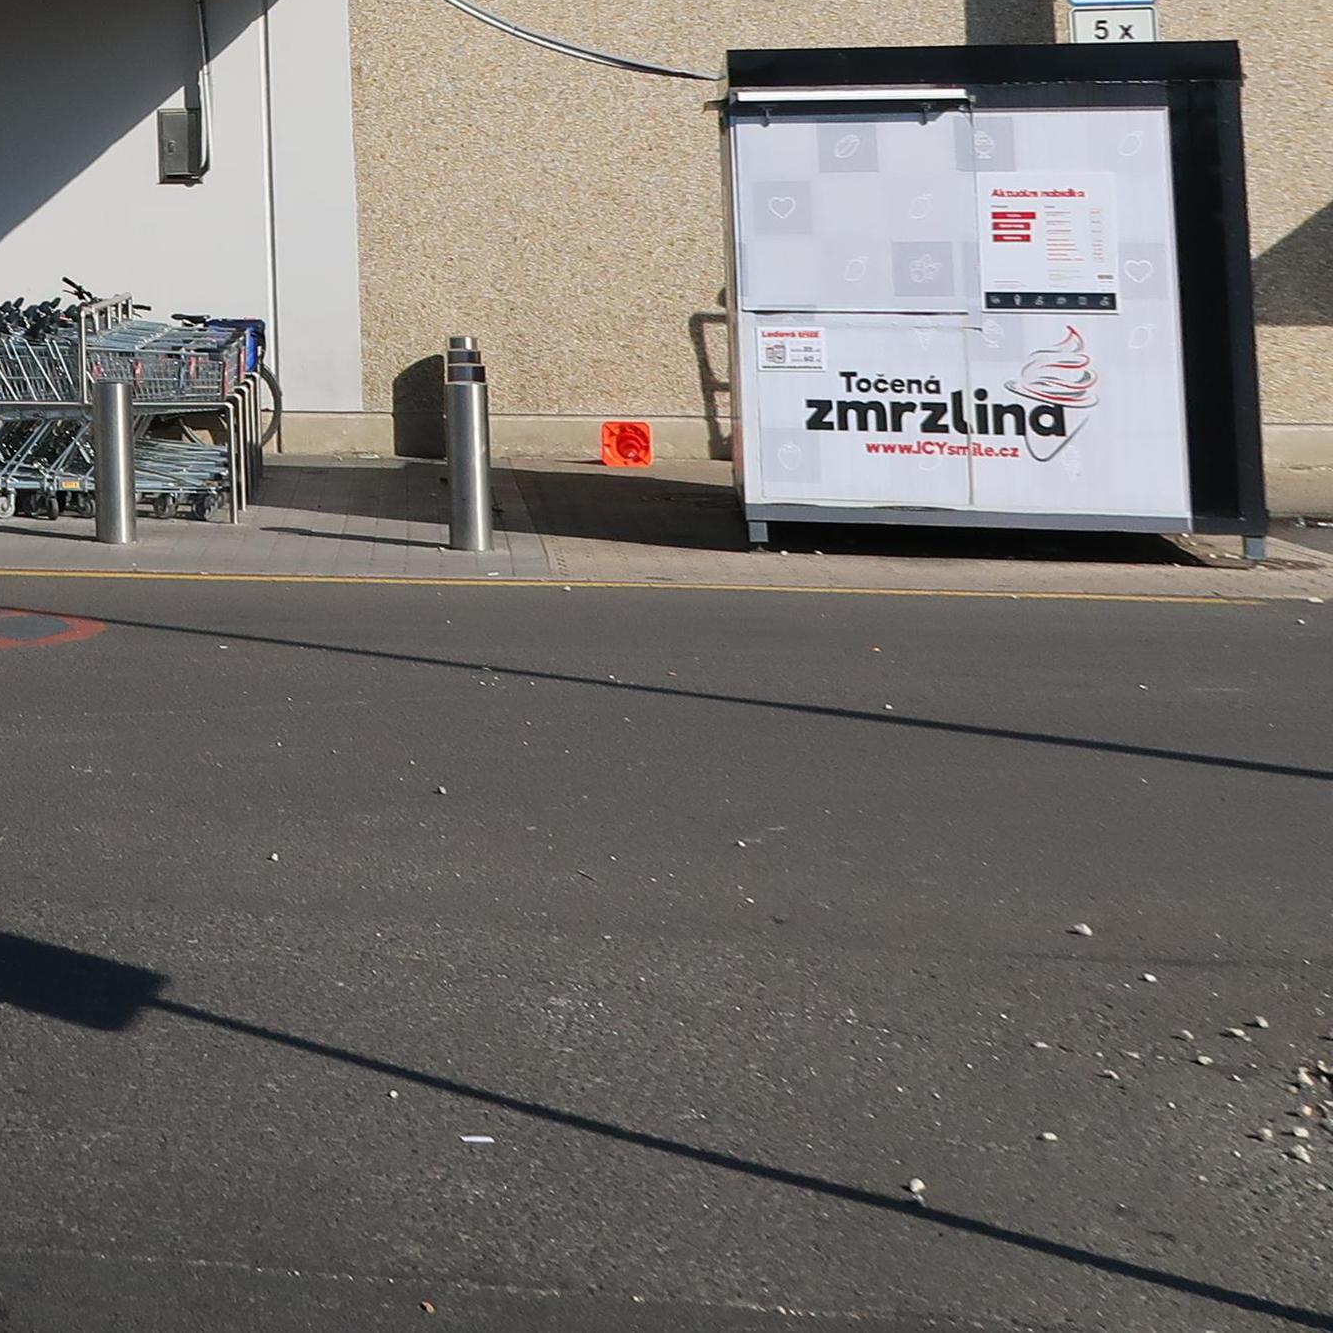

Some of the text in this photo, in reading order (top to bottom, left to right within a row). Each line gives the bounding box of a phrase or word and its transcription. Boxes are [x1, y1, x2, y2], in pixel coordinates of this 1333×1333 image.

[1094, 20, 1135, 40] 5 x
[839, 370, 942, 394] Točená
[805, 388, 1067, 436] zmrzlina
